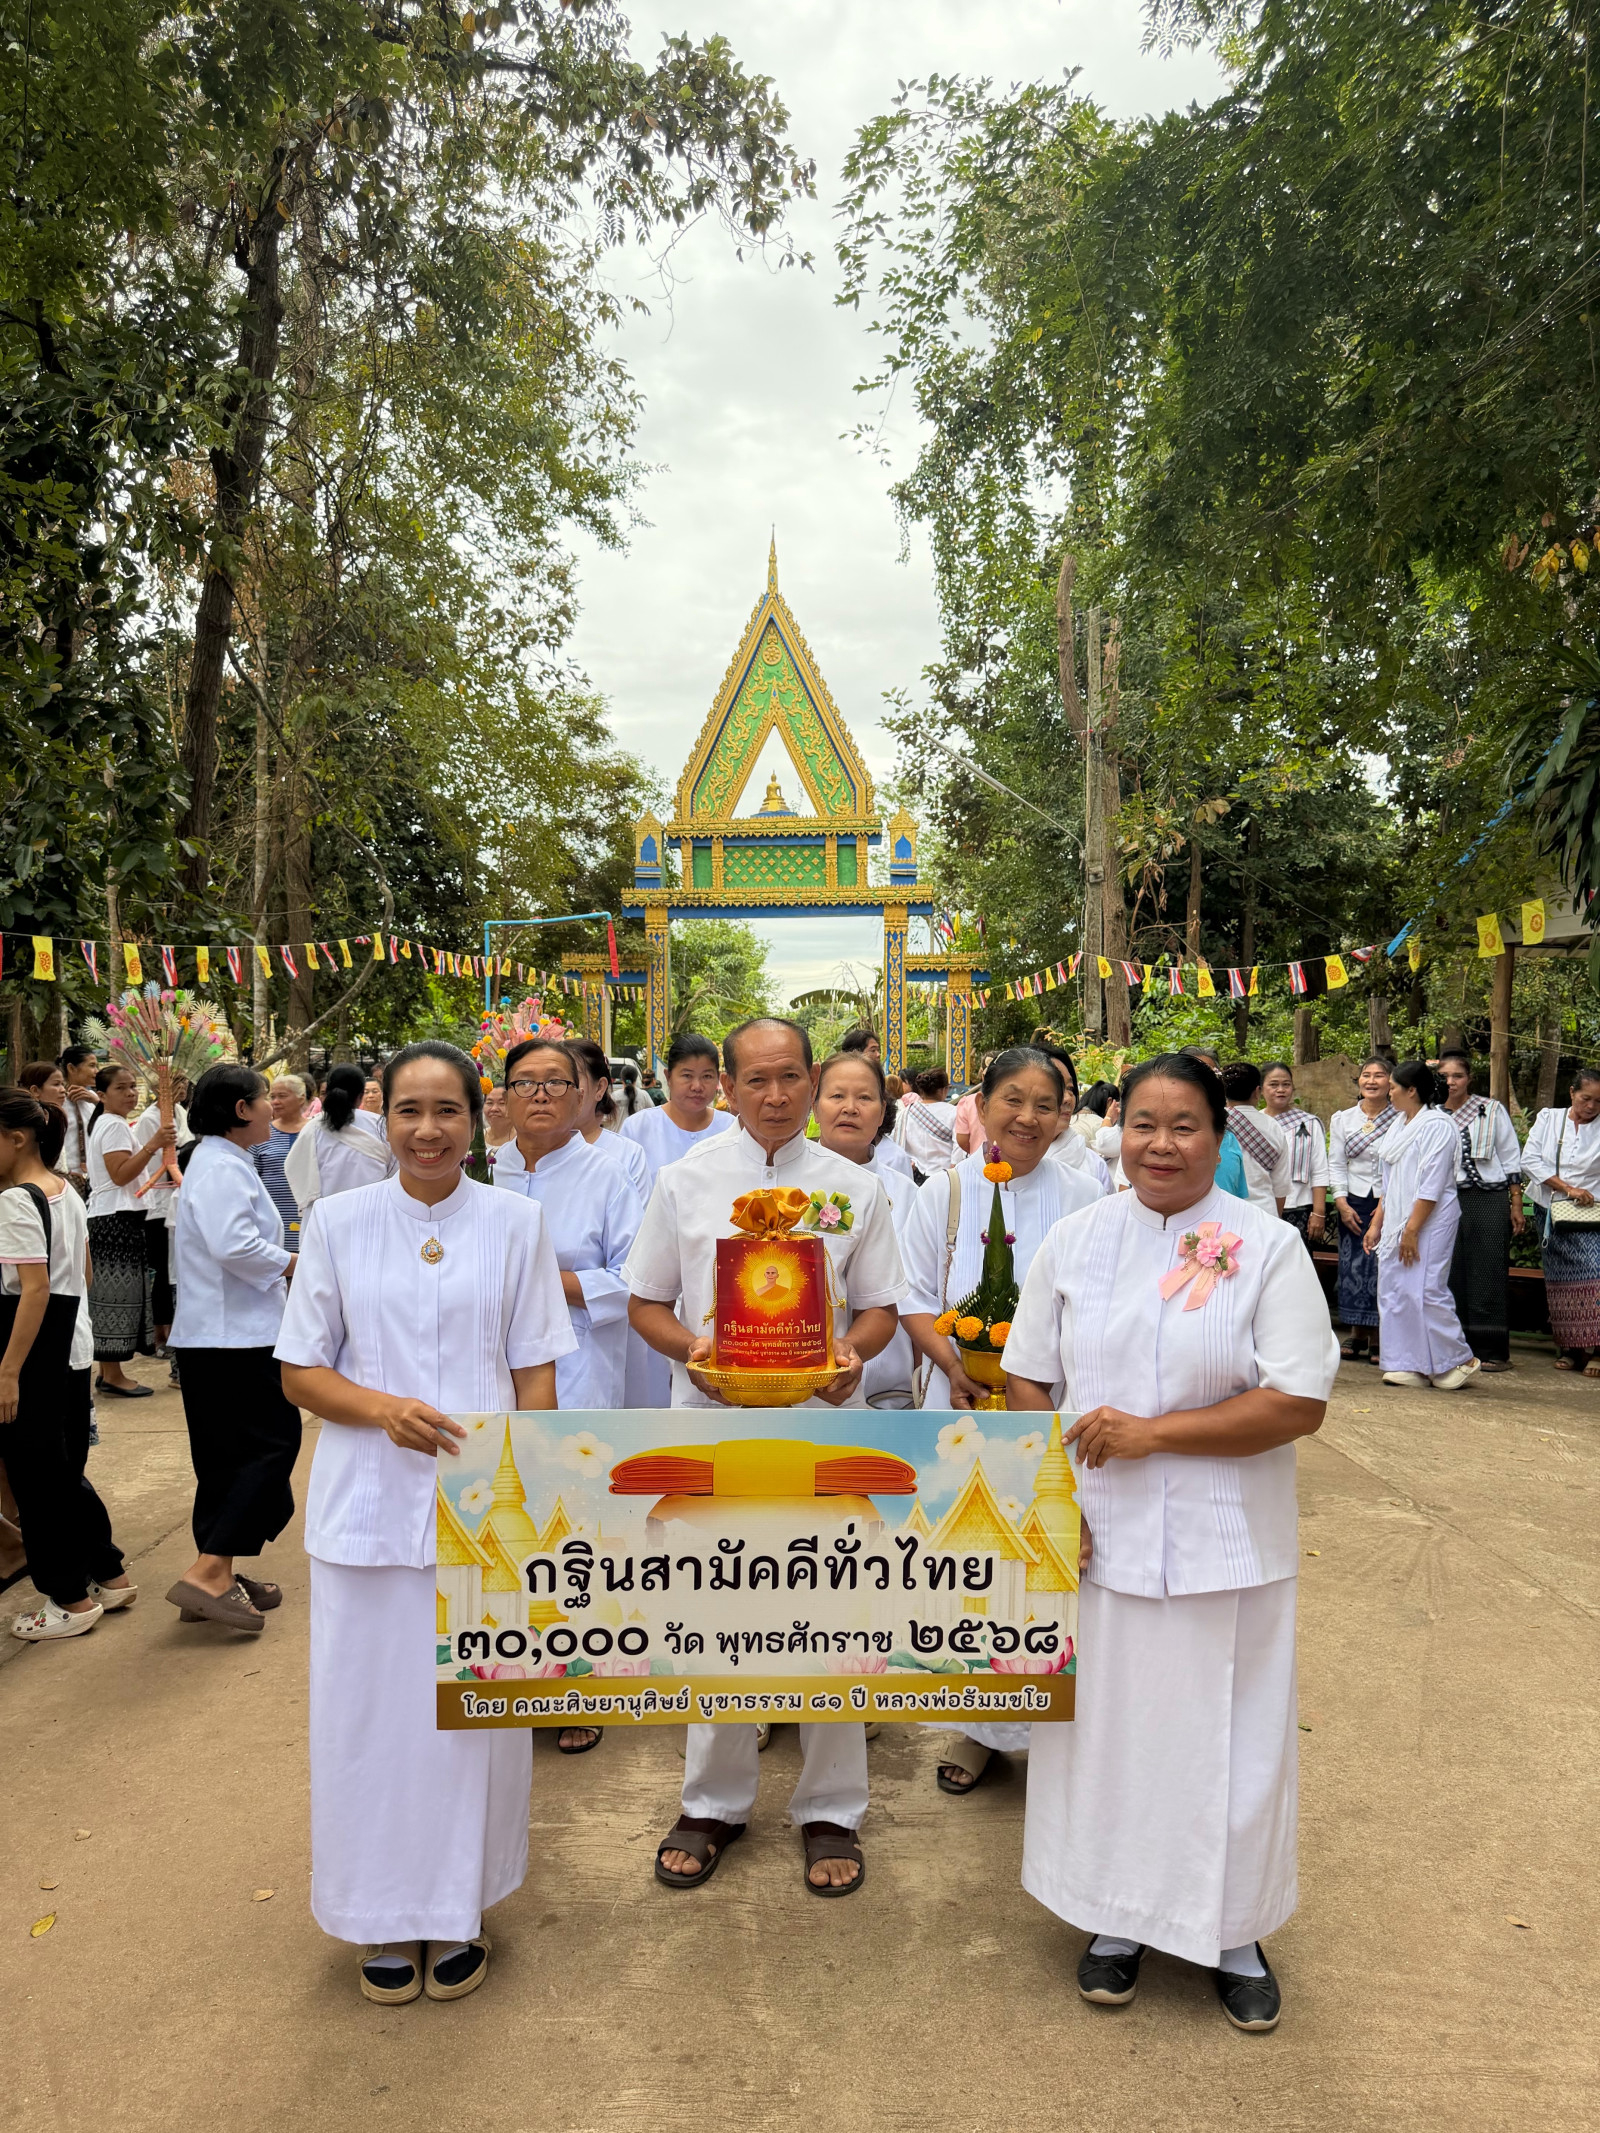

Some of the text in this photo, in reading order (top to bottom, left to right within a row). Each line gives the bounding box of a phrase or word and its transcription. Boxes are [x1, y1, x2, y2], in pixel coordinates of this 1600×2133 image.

[723, 1318, 821, 1336] กฐินสามัคคีทั่วไทย
[525, 1522, 994, 1609] กฐินสามัคคีทั่วไทย
[457, 1618, 1060, 1666] ๓๐,๐๐๐ วัด พุทธศักราช ๒๕๖๘
[463, 1687, 1049, 1717] โดย คณะศิษยานุศิษย์ บูชาธรรม ๘๑ ปี หลวงพ่อธัมมชโย
